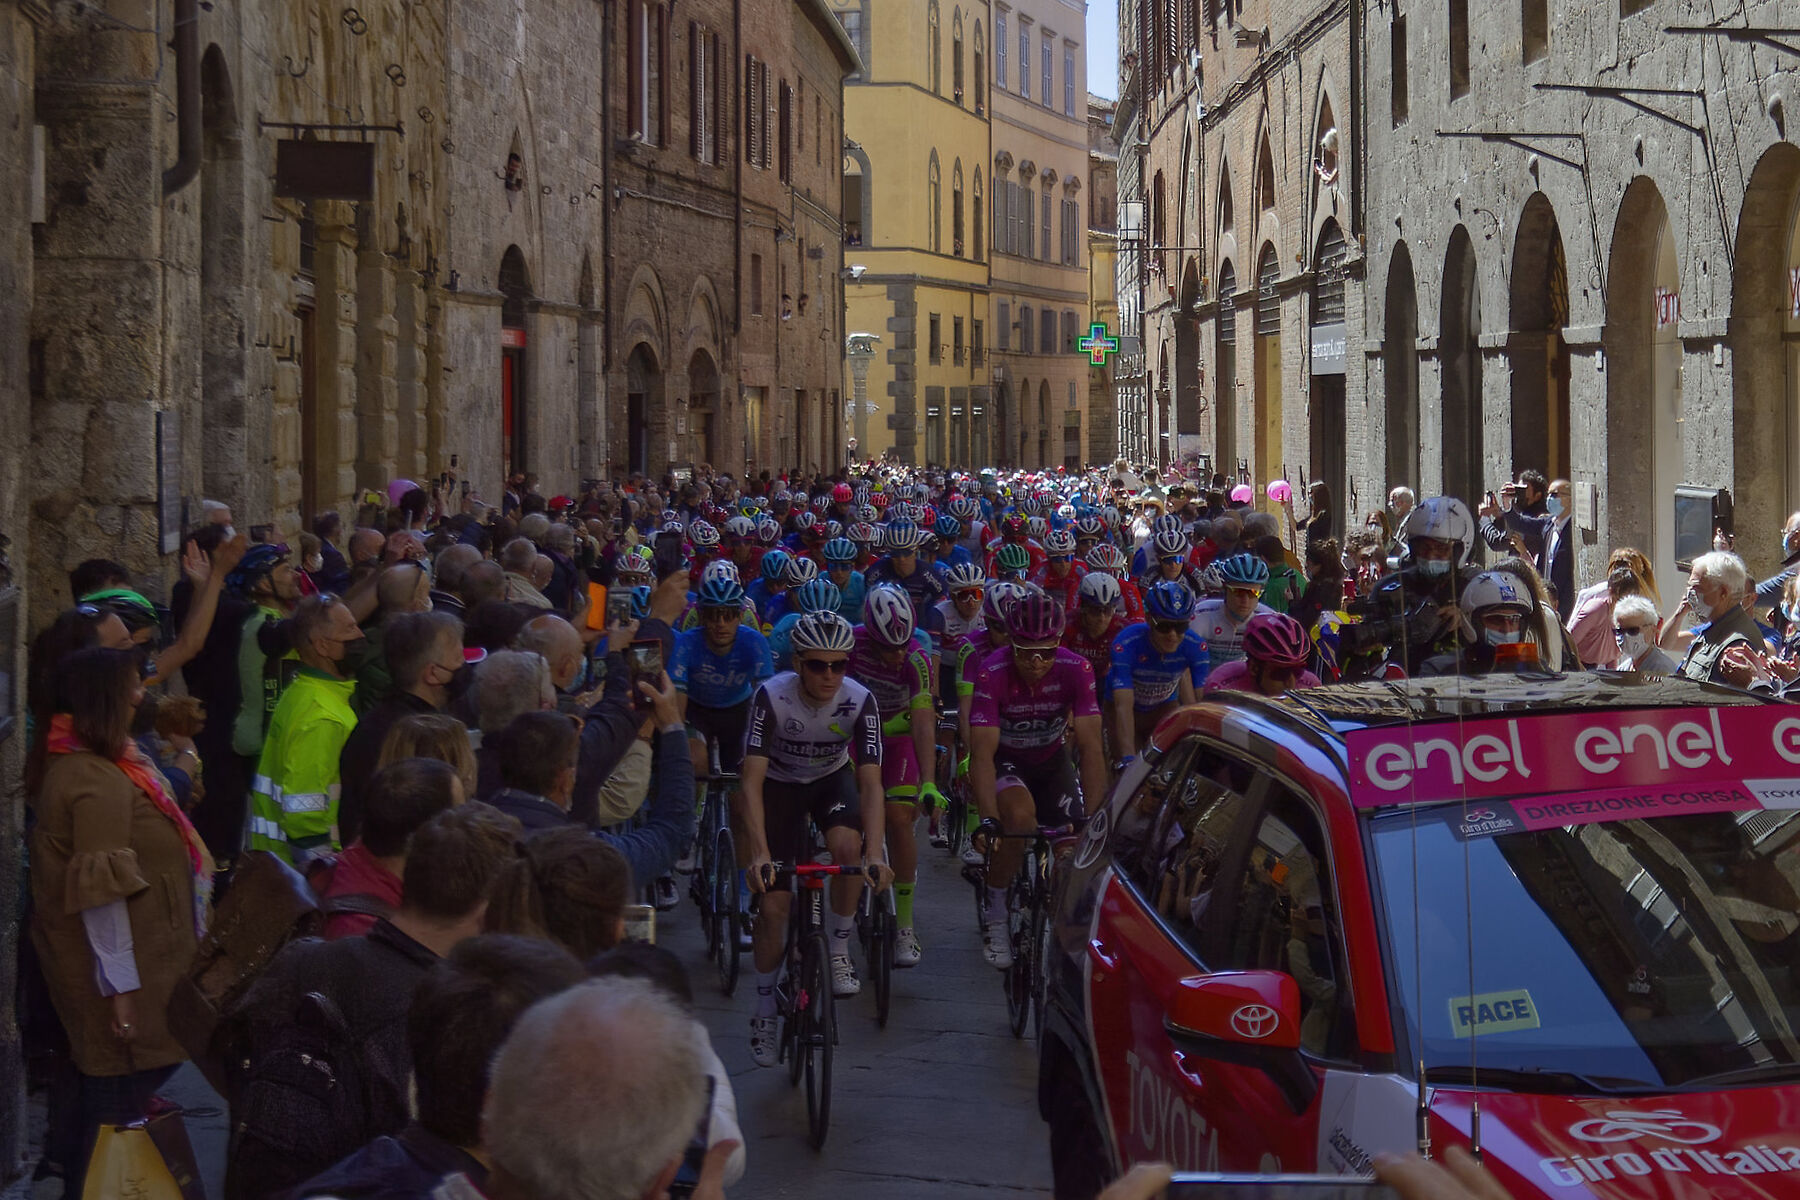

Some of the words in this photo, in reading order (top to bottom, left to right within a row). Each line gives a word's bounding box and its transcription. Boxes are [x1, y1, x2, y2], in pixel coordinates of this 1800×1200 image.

[1654, 287, 1681, 331] Yam
[749, 704, 768, 749] BMC
[863, 713, 880, 759] BMC
[1365, 720, 1532, 791] enel
[1575, 708, 1733, 775] enel
[1525, 793, 1660, 820] DIREZIONE
[1661, 789, 1748, 806] CORSA
[1457, 998, 1531, 1027] RACE
[1539, 1152, 1653, 1187] Giro
